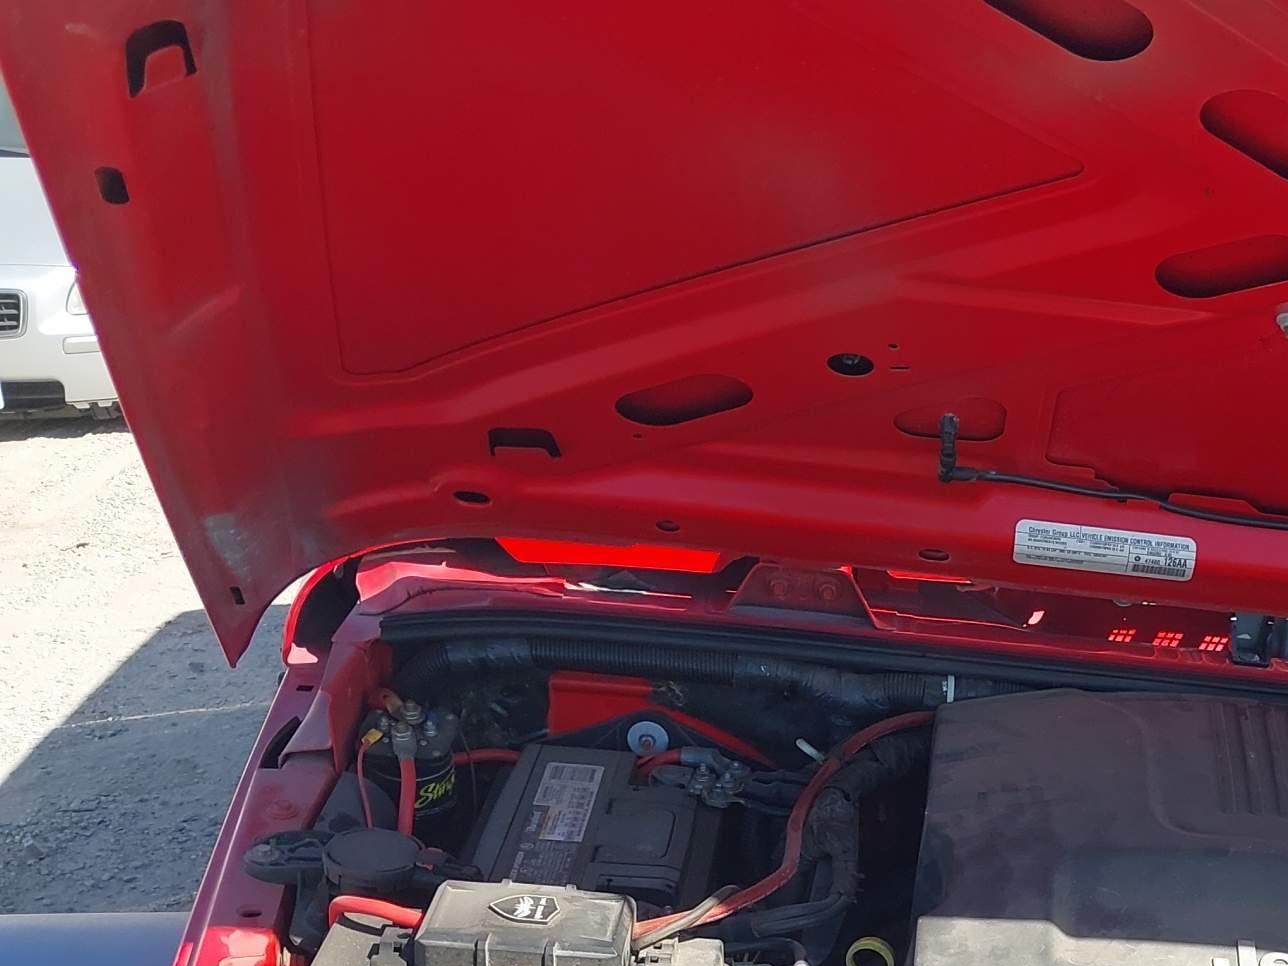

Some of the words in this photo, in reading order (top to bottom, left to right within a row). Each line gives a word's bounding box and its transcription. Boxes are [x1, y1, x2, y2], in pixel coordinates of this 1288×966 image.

[1069, 531, 1080, 539] LLC
[1081, 532, 1103, 542] VEHICLE
[1104, 535, 1129, 545] EMISSION
[1130, 538, 1153, 547] CONTROL
